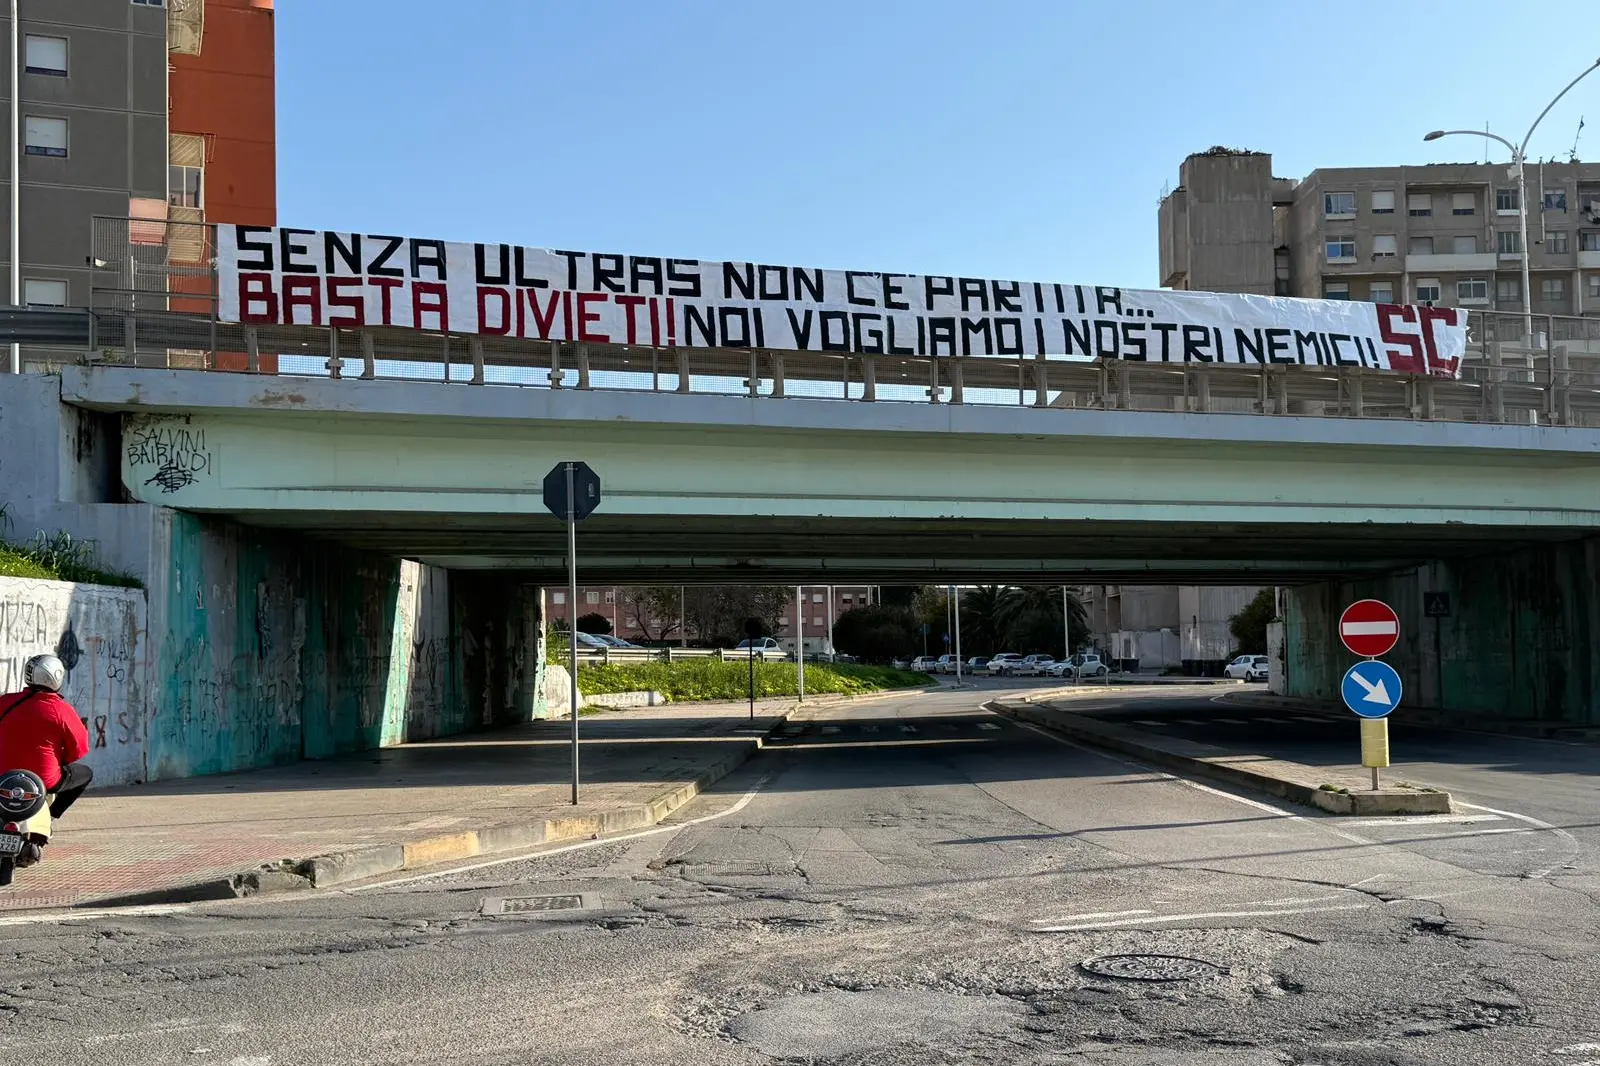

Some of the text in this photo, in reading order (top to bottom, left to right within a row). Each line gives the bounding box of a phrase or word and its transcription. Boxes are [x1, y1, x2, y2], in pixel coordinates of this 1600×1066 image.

[236, 225, 447, 280] SENZA
[474, 243, 701, 297] ULTRAS
[722, 261, 824, 302] NON
[238, 272, 1380, 369] BASTA DIVIETI! NOI VOGLIAMO I NOSTRI NEMICI!
[1376, 303, 1459, 380] SC
[130, 427, 206, 453] SALVINI
